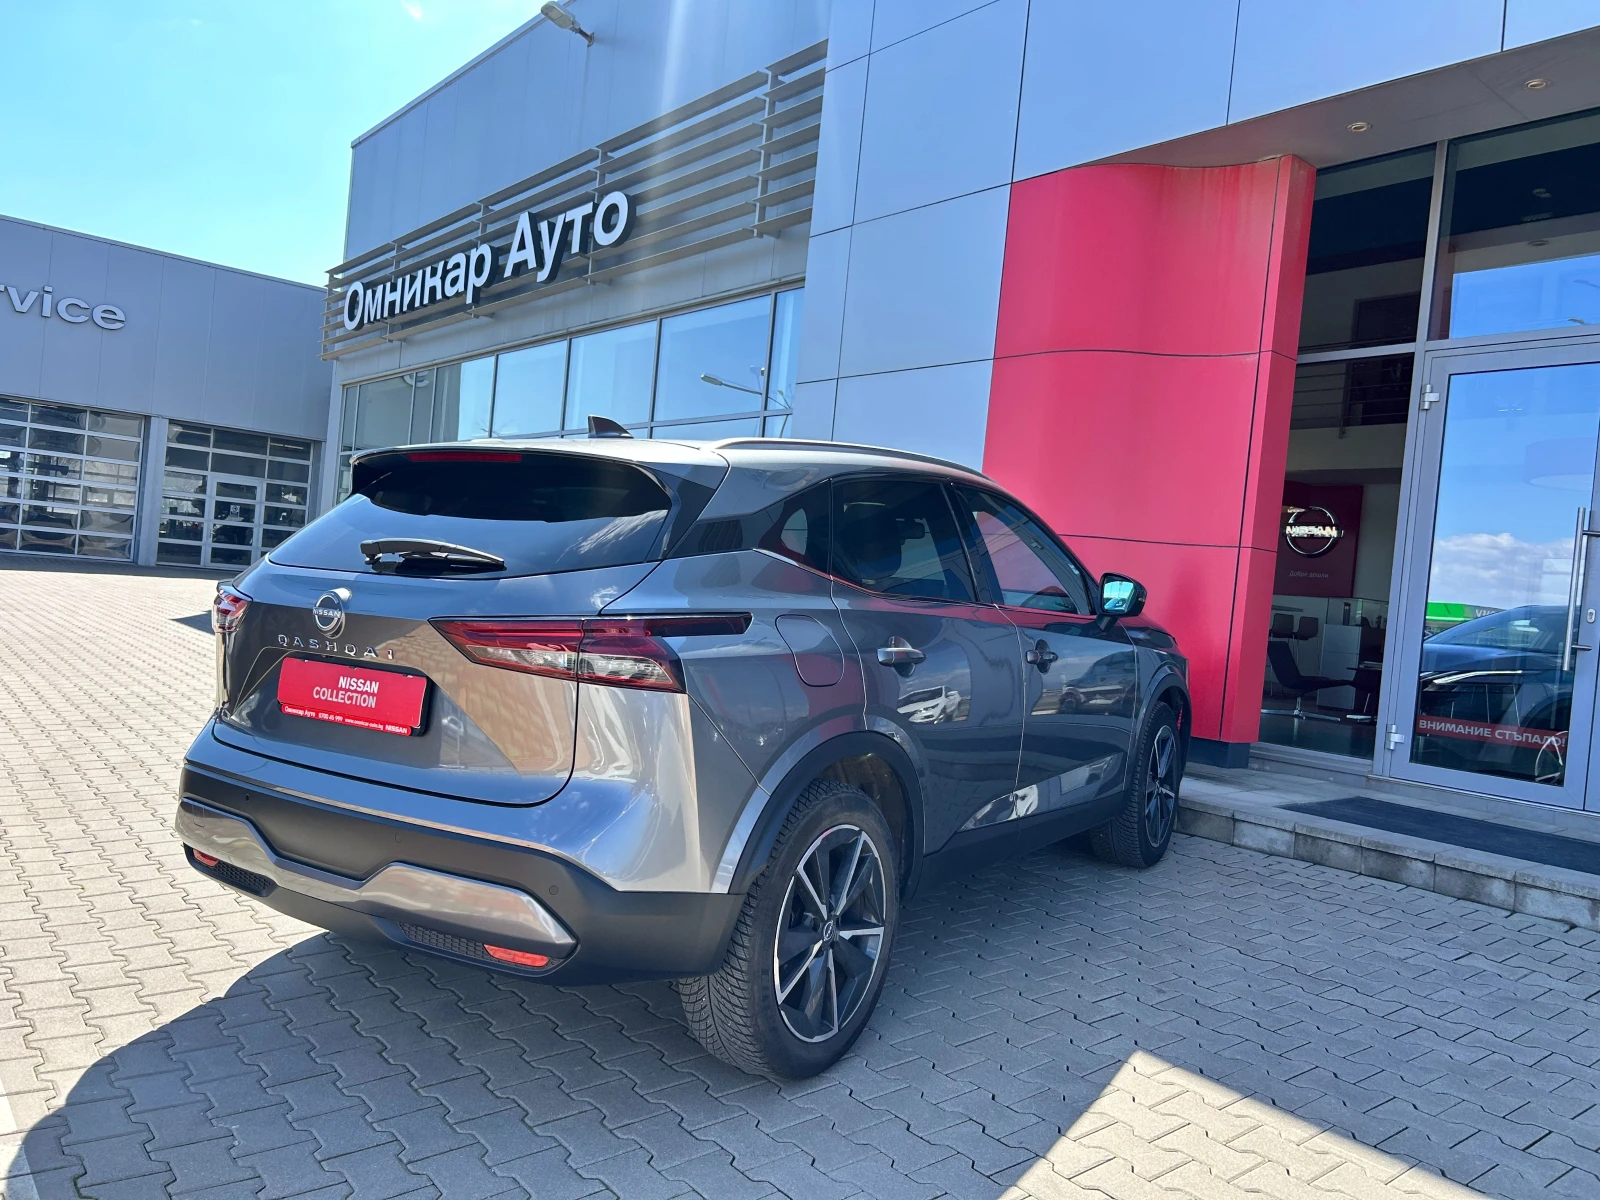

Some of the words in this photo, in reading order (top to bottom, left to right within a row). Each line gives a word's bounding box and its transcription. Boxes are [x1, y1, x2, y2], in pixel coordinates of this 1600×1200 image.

[343, 243, 493, 331] Омникар
[503, 190, 630, 283] Ауто
[0, 284, 126, 330] vice
[1285, 525, 1337, 537] NISSAN
[312, 607, 341, 618] NISSAN
[277, 634, 394, 660] QASHQAI
[338, 675, 379, 694] NISSAN
[313, 686, 377, 709] COLLECTION
[385, 724, 408, 734] NISSAN
[1418, 719, 1492, 738] ВНИМАНИЕ
[1494, 729, 1566, 747] СТЪПАЛО!
